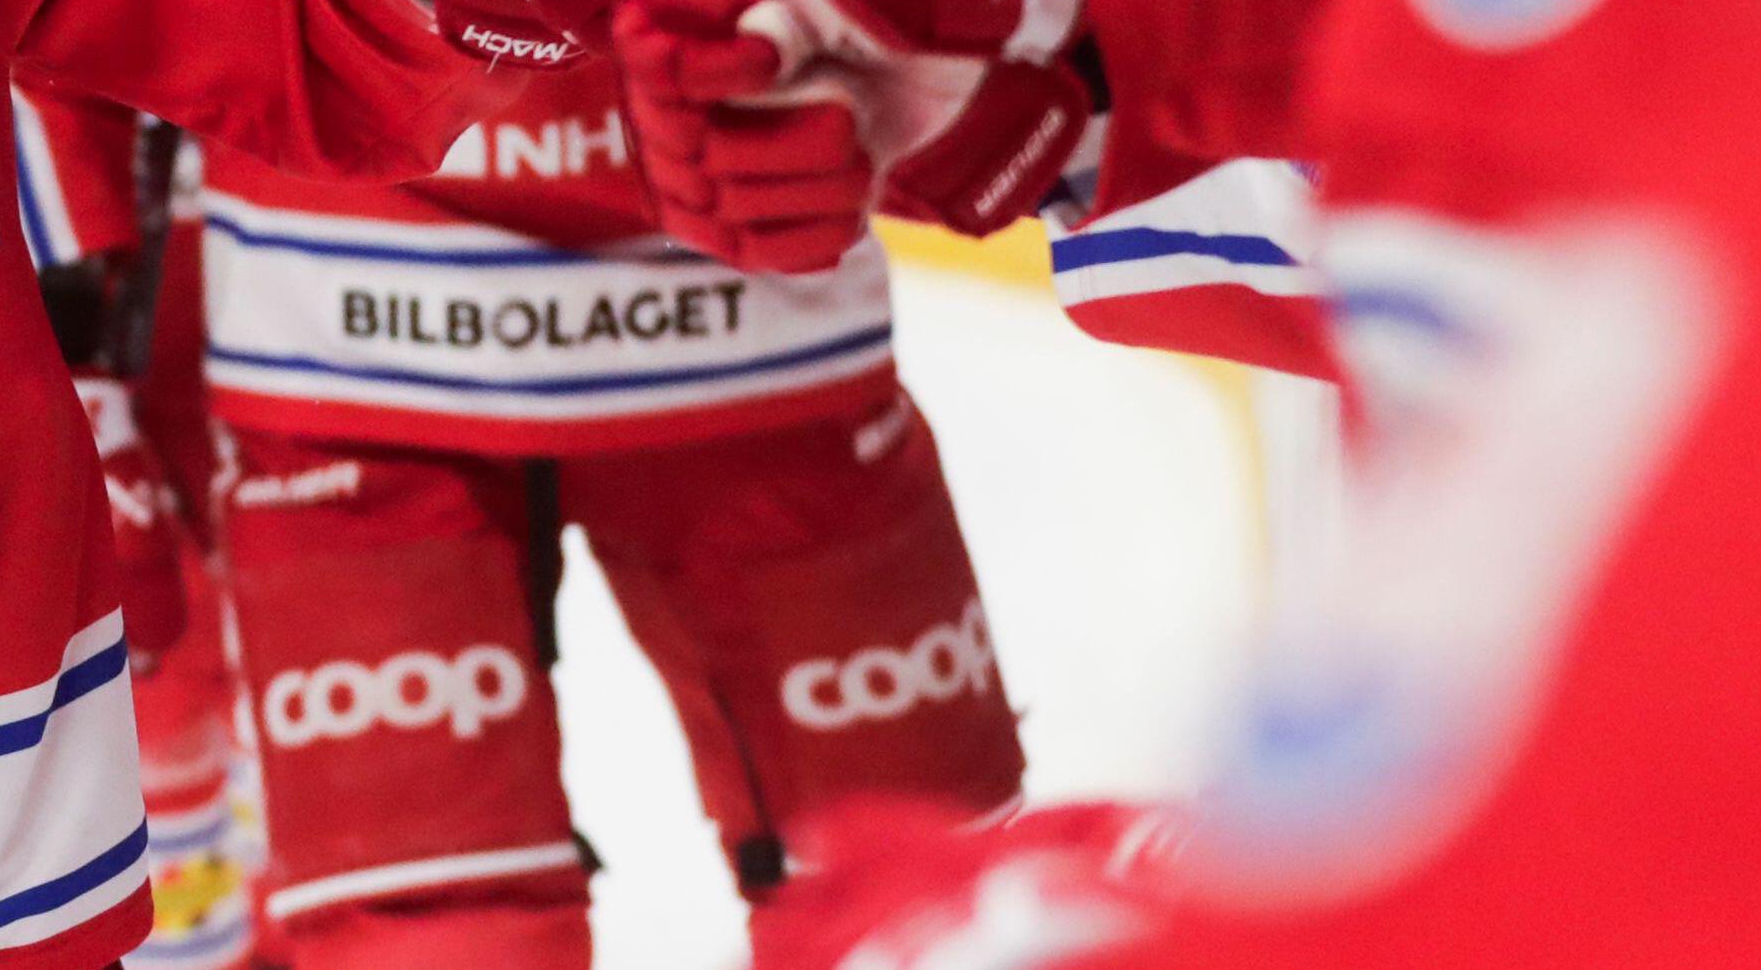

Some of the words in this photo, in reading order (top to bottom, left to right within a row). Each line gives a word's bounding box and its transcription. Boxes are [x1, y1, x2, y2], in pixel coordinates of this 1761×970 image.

[462, 24, 569, 63] MACH
[495, 105, 630, 178] NH
[343, 280, 746, 350] BILBOLAGET
[264, 645, 529, 748] coop
